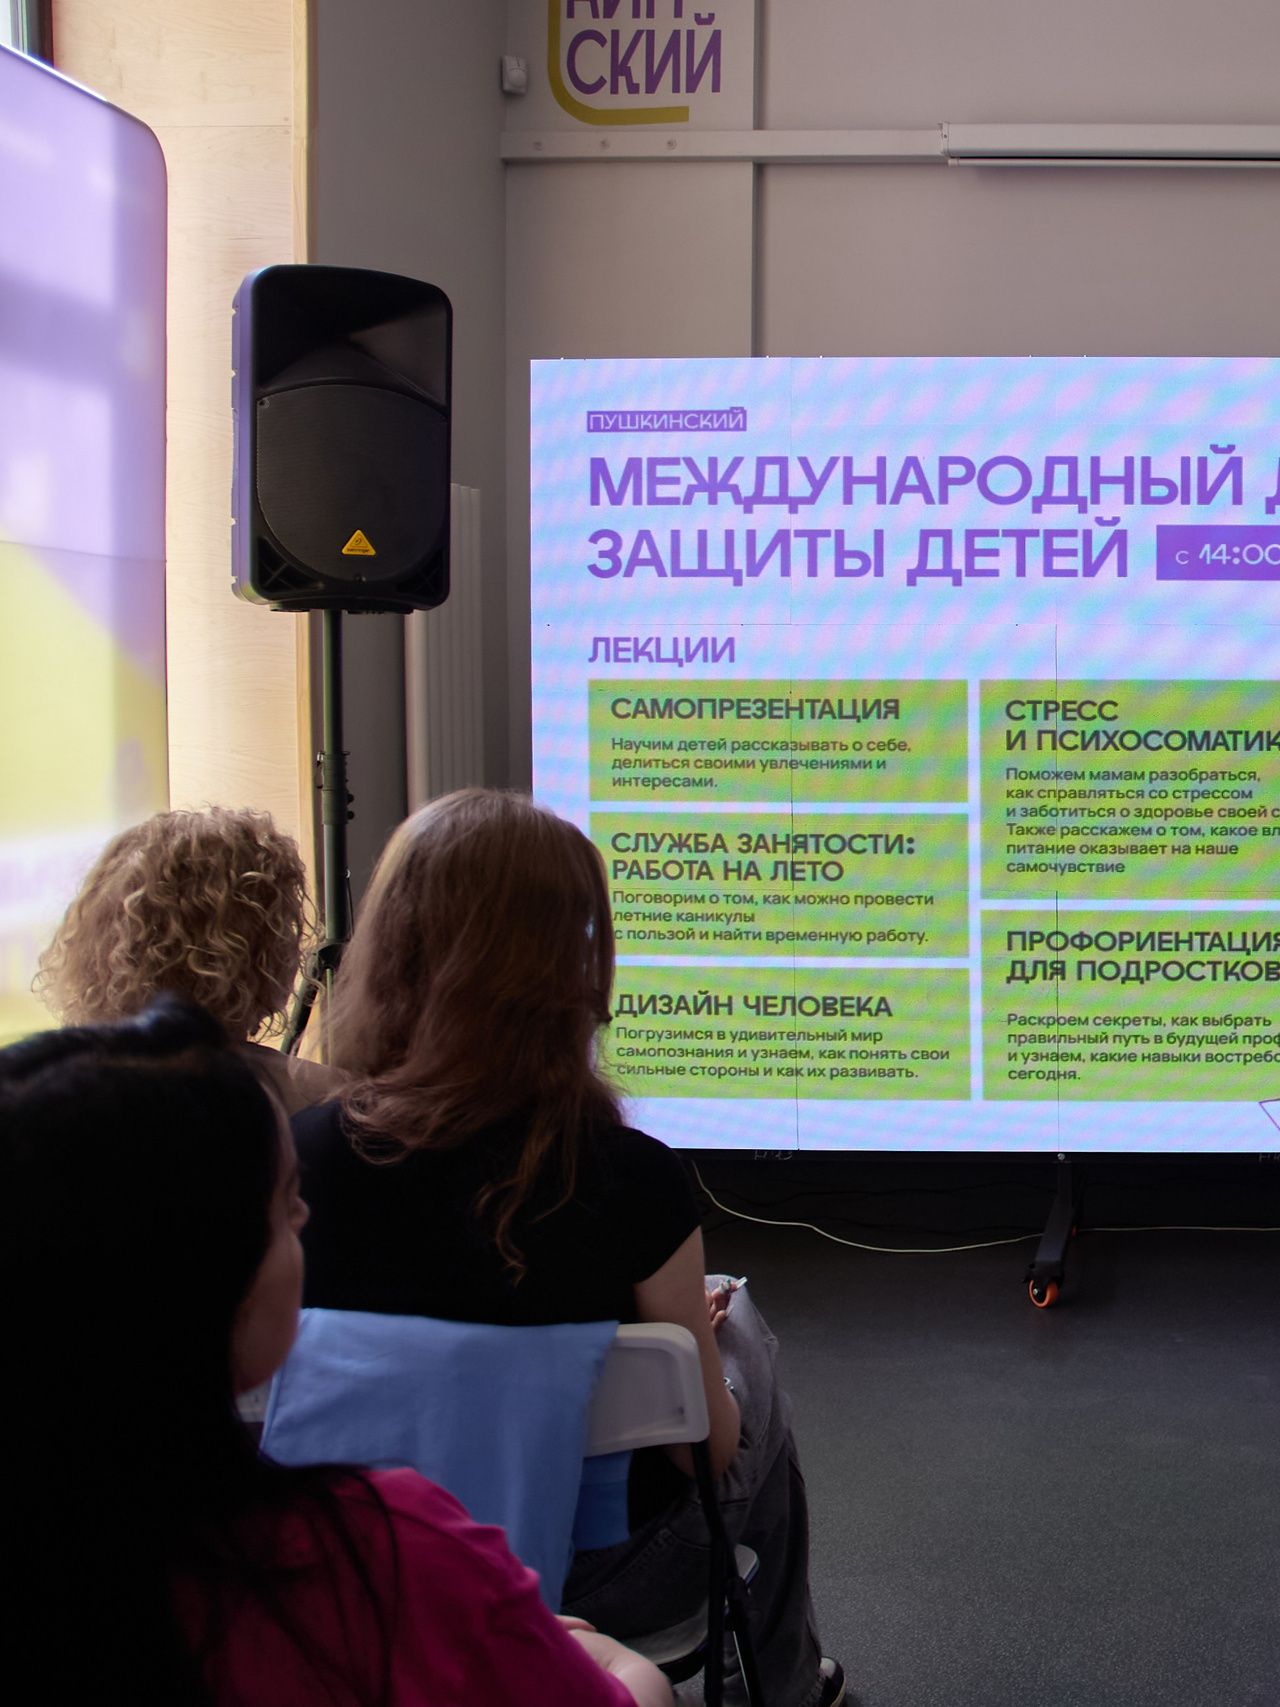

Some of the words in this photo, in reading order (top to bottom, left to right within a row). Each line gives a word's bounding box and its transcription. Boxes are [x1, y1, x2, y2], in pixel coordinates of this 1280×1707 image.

[567, 13, 721, 95] СКИЙ
[590, 409, 743, 429] ПУШКИНСКИЙ
[590, 445, 1243, 514] МЕЖДУНАРОДНЫЙ
[588, 529, 884, 586] ЗАЩИТЫ
[907, 516, 1128, 586] ДЕТЕЙ
[1174, 549, 1189, 566] с
[588, 637, 735, 667] ЛЕКЦИИ
[611, 698, 899, 723] САМОПРЕЗЕНТАЦИЯ
[1006, 700, 1118, 721] СТРЕСС
[612, 737, 673, 755] Научим
[677, 737, 727, 754] детей
[731, 739, 849, 755] рассказывать
[851, 739, 864, 752] о
[1006, 730, 1026, 750] И
[612, 757, 690, 771] делиться
[694, 758, 755, 770] своими
[760, 758, 872, 773] увлечениями
[876, 758, 887, 770] и
[613, 775, 717, 791] интересами.
[1006, 766, 1085, 782] Поможем
[1089, 770, 1145, 781] мамам
[1149, 767, 1260, 785] разобраться,
[1006, 788, 1033, 799] как
[1037, 788, 1144, 803] справляться
[1147, 788, 1169, 800] со
[1172, 788, 1252, 803] стрессом
[1006, 807, 1017, 818] и
[1021, 804, 1116, 819] заботиться
[1119, 807, 1131, 819] о
[1134, 807, 1214, 822] здоровье
[1217, 805, 1267, 819] своей
[1006, 823, 1056, 836] Также
[1060, 825, 1152, 840] расскажем
[1155, 825, 1167, 837] о
[1171, 825, 1205, 838] том,
[1211, 825, 1258, 837] какое
[612, 833, 729, 853] СЛУЖБА
[738, 833, 914, 854] ЗАНЯТОСТИ:
[1007, 843, 1075, 855] питание
[1079, 843, 1167, 856] оказывает
[1170, 844, 1192, 855] на
[1195, 844, 1239, 855] наше
[613, 860, 714, 880] РАБОТА
[724, 860, 761, 881] НА
[770, 860, 844, 881] ЛЕТО
[1007, 862, 1125, 877] самочувствие
[613, 889, 705, 908] Поговорим
[708, 893, 721, 905] о
[723, 893, 758, 906] том,
[763, 893, 790, 905] как
[795, 893, 850, 906] можно
[854, 894, 934, 909] провести
[614, 910, 672, 923] летние
[677, 911, 755, 927] каникулы
[614, 928, 624, 941] с
[627, 927, 695, 941] пользой
[698, 929, 710, 941] и
[713, 927, 762, 941] найти
[766, 930, 863, 945] временную
[867, 928, 928, 946] работу.
[1006, 960, 1066, 984] ДЛЯ
[1077, 960, 1280, 985] ПОДРОСТКОВ
[615, 990, 733, 1018] ДИЗАЙН
[743, 996, 892, 1017] ЧЕЛОВЕКА
[1007, 1012, 1089, 1029] Раскроем
[1093, 1015, 1166, 1030] секреты,
[1172, 1015, 1198, 1027] как
[1203, 1013, 1272, 1030] выбрать
[616, 1026, 713, 1043] Погрузимся
[716, 1030, 726, 1041] в
[730, 1028, 847, 1044] удивительный
[851, 1030, 883, 1045] мир
[1008, 1031, 1109, 1048] правильный
[1113, 1033, 1150, 1048] путь
[1153, 1034, 1164, 1045] в
[1166, 1031, 1238, 1048] будущей
[617, 1046, 733, 1058] самопознания
[737, 1048, 748, 1059] и
[751, 1048, 814, 1062] узнаем,
[819, 1048, 845, 1060] как
[849, 1048, 907, 1060] понять
[911, 1049, 949, 1061] свои
[1007, 1051, 1018, 1062] и
[1021, 1049, 1085, 1066] узнаем,
[1090, 1051, 1137, 1063] какие
[1142, 1051, 1201, 1063] навыки
[616, 1063, 686, 1076] сильные
[689, 1065, 759, 1080] стороны
[763, 1066, 773, 1077] и
[777, 1066, 804, 1078] как
[806, 1066, 827, 1078] их
[830, 1066, 918, 1081] развивать.
[1008, 1069, 1080, 1082] сегодня.
